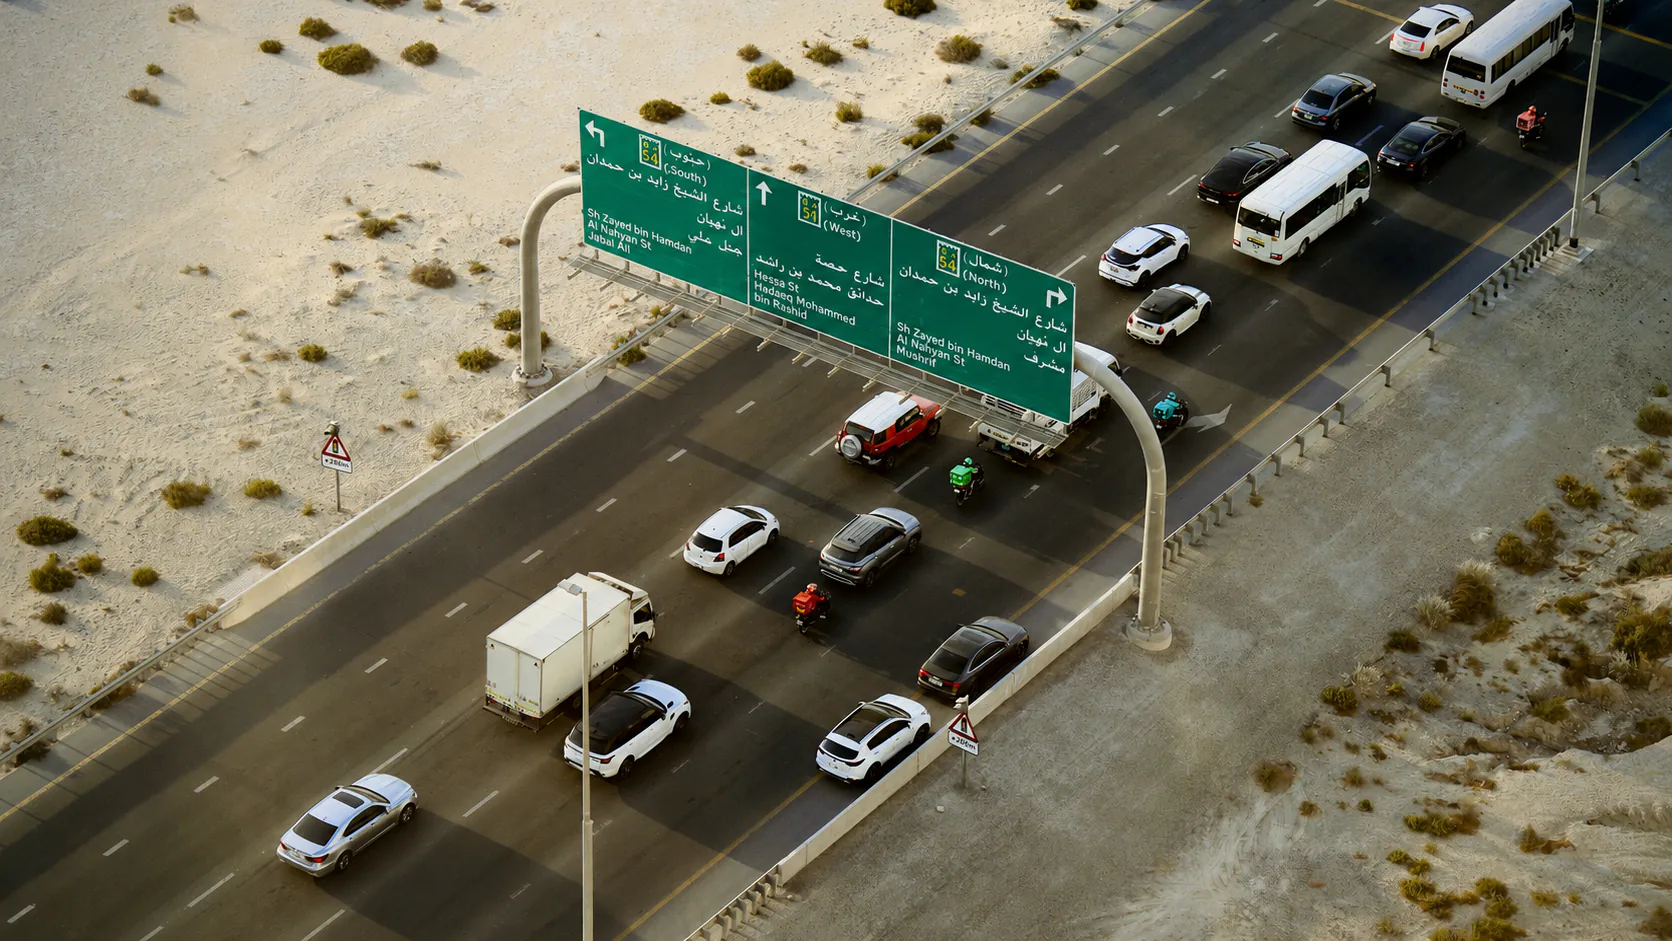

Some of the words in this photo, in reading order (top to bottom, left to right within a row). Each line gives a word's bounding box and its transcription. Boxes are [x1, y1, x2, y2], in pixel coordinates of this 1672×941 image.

[586, 152, 624, 171] حمدان
[628, 167, 642, 182] بن
[647, 175, 669, 191] زايد
[673, 183, 708, 202] الشيخ
[712, 198, 743, 216] شارع
[587, 207, 600, 221] Sh
[602, 213, 632, 232] Zayed
[633, 224, 649, 239] bin
[651, 231, 693, 255] Hamdan
[696, 212, 727, 231] نهيان
[823, 219, 861, 243] (West)
[587, 219, 598, 231] Al
[601, 225, 638, 245] Nahyan
[640, 239, 652, 251] St
[588, 231, 614, 248] Jabal
[688, 231, 712, 246] علي
[756, 255, 785, 273] راشد
[788, 266, 803, 280] بن
[815, 253, 848, 273] حصة
[754, 269, 785, 289] Hessa
[788, 281, 800, 294] St
[807, 274, 842, 292] محمد
[853, 270, 885, 288] شارع
[899, 265, 939, 285] حمدان
[962, 269, 1007, 295] (North)
[943, 281, 958, 296] بن
[964, 289, 987, 306] زايد
[754, 281, 793, 304] Hadaeq
[796, 296, 856, 326] Mohammed
[754, 292, 770, 306] bin
[773, 299, 808, 320] Rashid
[992, 299, 1029, 319] الشيخ
[1034, 313, 1068, 334] شارع
[897, 322, 911, 335] Sh
[913, 327, 945, 347] Zayed
[947, 340, 964, 355] bin
[967, 347, 1011, 372] Hamdan
[1016, 328, 1049, 348] نهيان
[896, 345, 937, 368] Mushrif
[897, 333, 908, 346] Al
[910, 338, 950, 361] Nahyan
[953, 354, 966, 368] St
[1023, 350, 1066, 374] مشرف
